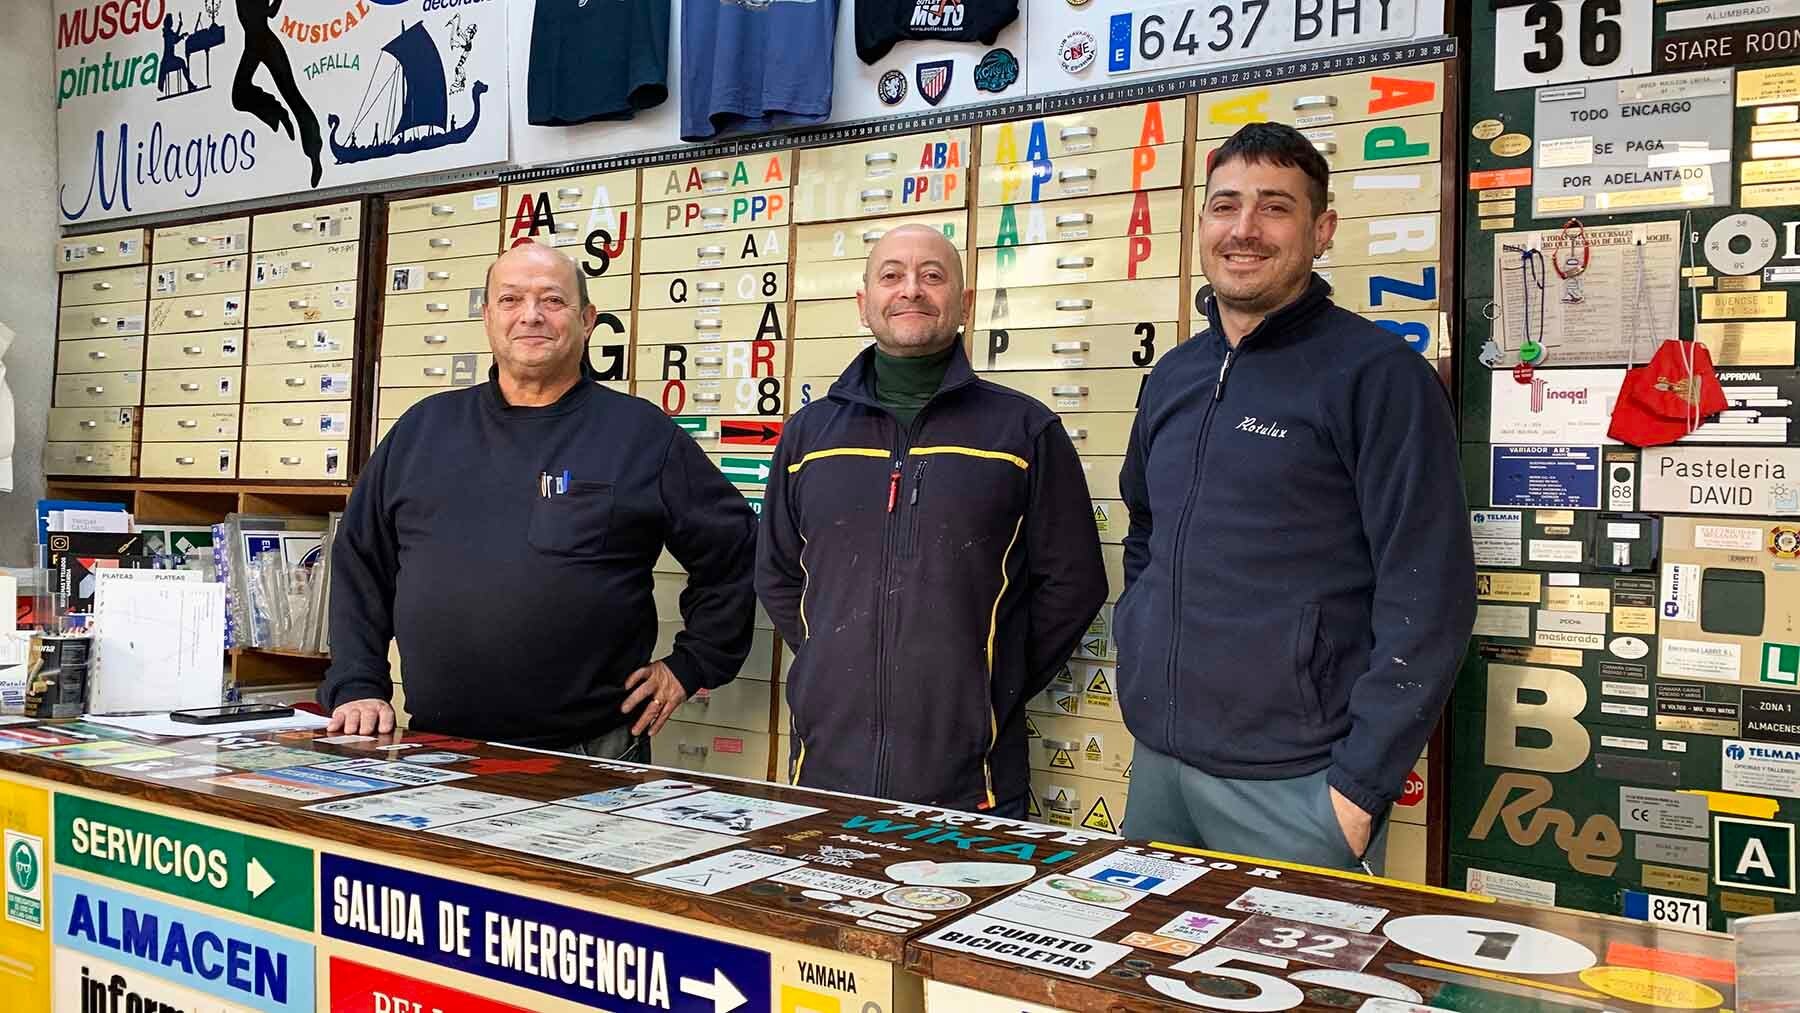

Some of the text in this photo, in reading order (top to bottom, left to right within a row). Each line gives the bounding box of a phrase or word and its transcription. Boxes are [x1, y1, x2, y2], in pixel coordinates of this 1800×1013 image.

[58, 0, 165, 49] MUSGO
[280, 1, 371, 44] MUSICAL
[910, 4, 964, 26] MOTO
[1706, 6, 1770, 20] ALUMBRADO
[1139, 0, 1394, 60] 6437 BHY
[1523, 0, 1622, 74] 36
[1115, 48, 1124, 62] E
[1664, 37, 1733, 62] STARE
[57, 51, 159, 109] pintura
[303, 53, 360, 81] TAFALLA
[1571, 101, 1692, 122] TODO ENCARGO
[1594, 143, 1614, 154] SE
[1626, 139, 1665, 152] PAGA
[60, 121, 256, 221] Milagros
[1563, 167, 1704, 188] POR ADELANTADO
[1132, 322, 1156, 367] 3
[1720, 372, 1762, 381] APPROVAL
[1235, 416, 1288, 438] Rotulux
[1660, 456, 1786, 480] Pasteleria
[1611, 486, 1632, 499] 68
[1690, 485, 1753, 506] DAVID
[1487, 513, 1519, 521] TELMAN
[1767, 646, 1796, 682] L
[1484, 663, 1591, 774] B
[1760, 701, 1792, 712] ZONA 1
[1748, 721, 1800, 734] ALMACENES
[1631, 808, 1649, 822] CE
[71, 817, 228, 889] SERVICIOS
[1735, 837, 1776, 878] A
[1653, 899, 1700, 925] 8371
[67, 893, 288, 1005] ALMACEN
[333, 875, 670, 1010] SALIDA DE EMERGENCIA
[938, 931, 1097, 974] BICICLETAS
[983, 924, 1094, 954] CUARTO
[1258, 927, 1349, 958] 32
[798, 960, 857, 994] YAMAHA
